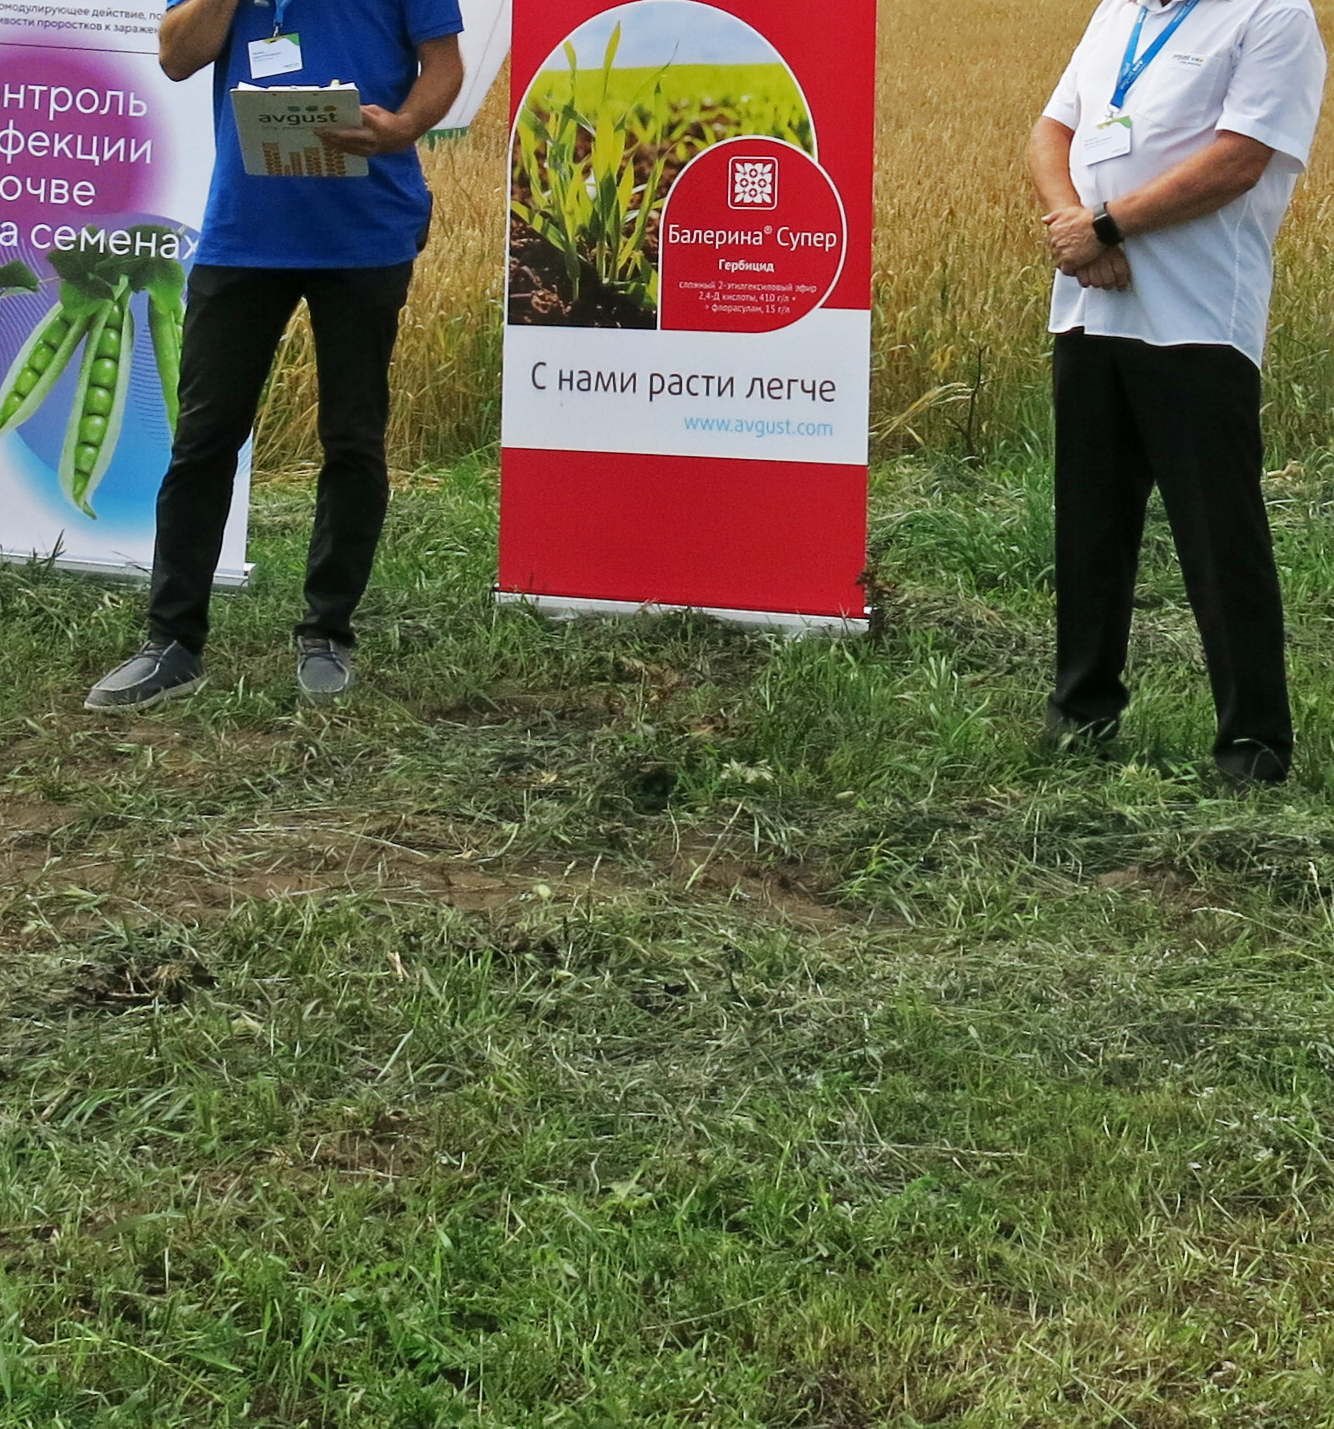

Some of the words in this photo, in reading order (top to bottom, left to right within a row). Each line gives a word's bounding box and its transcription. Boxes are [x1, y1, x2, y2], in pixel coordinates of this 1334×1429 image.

[92, 7, 147, 20] действие,
[37, 18, 102, 31] проростков
[258, 112, 338, 126] avgust
[30, 225, 199, 260] семенах
[776, 226, 837, 252] Супер
[718, 259, 775, 273] Гербицид
[759, 293, 775, 302] 410
[765, 304, 776, 313] 15
[531, 361, 547, 390] С
[558, 368, 637, 394] нами
[649, 371, 735, 402] расти
[745, 375, 837, 403] легче
[684, 415, 834, 438] www.avgust.com
